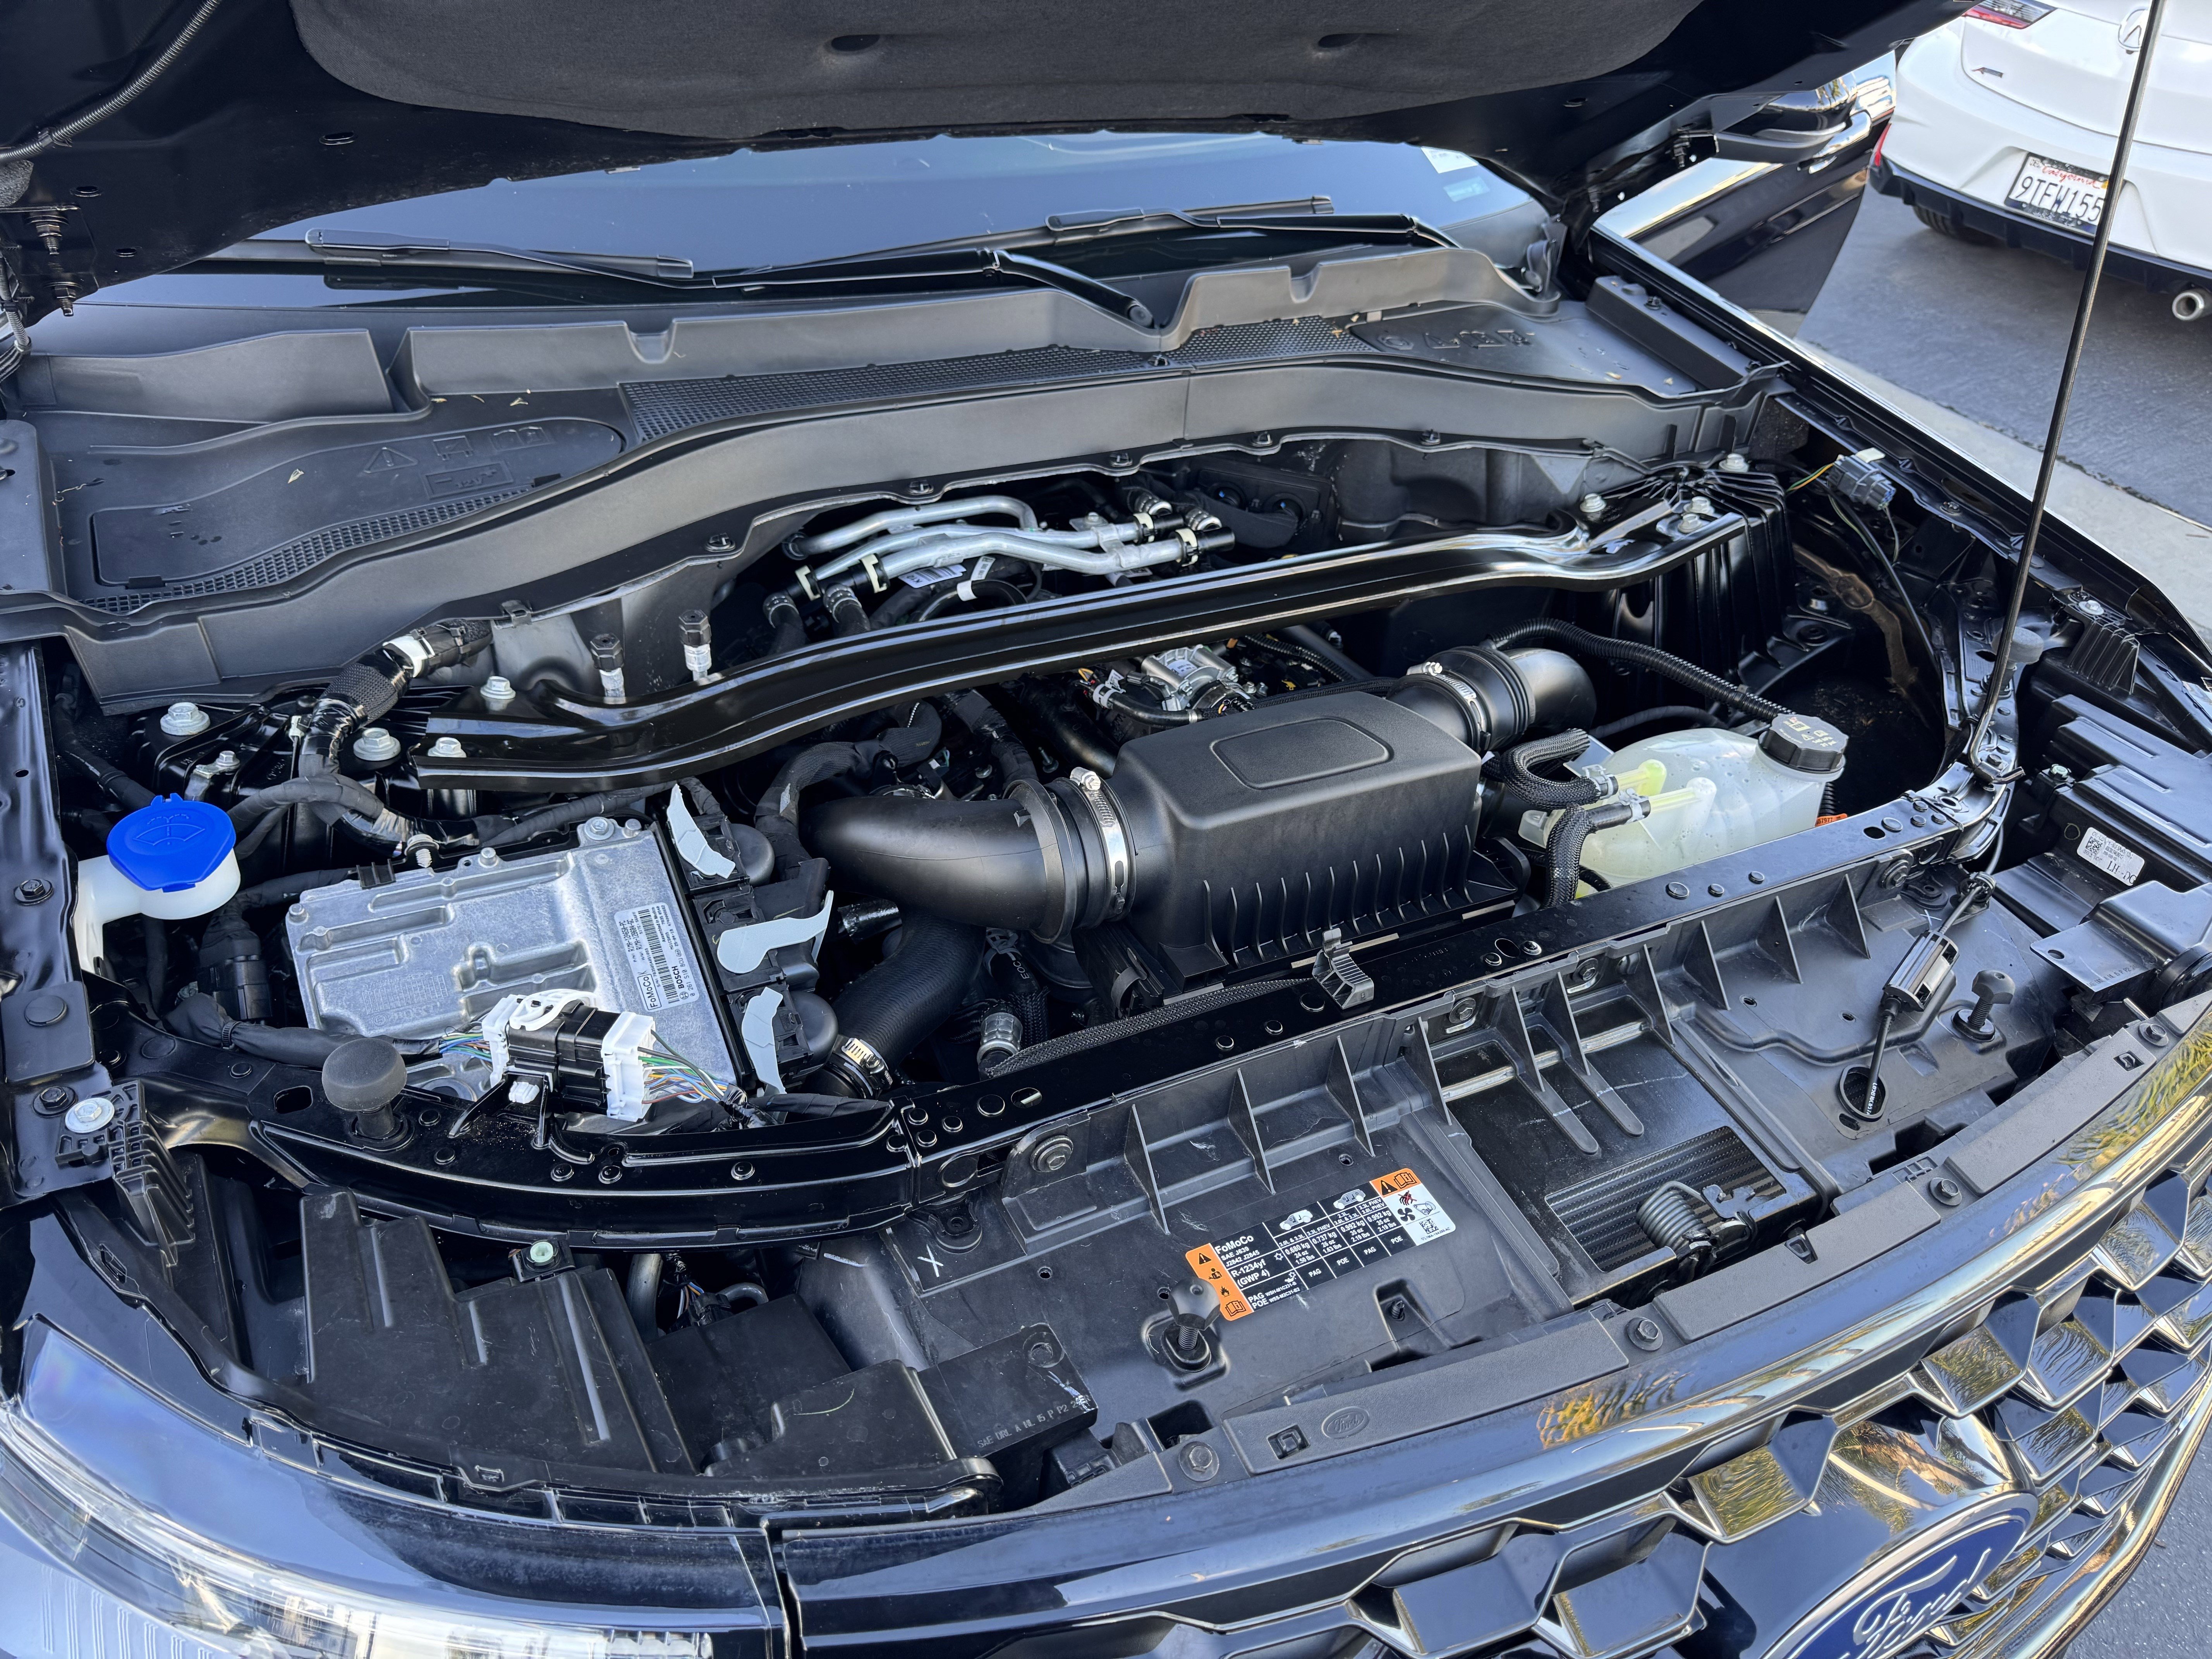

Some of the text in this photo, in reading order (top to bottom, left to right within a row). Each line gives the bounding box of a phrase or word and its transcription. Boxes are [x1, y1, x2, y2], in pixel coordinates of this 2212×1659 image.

[2016, 176, 2104, 222] 9TFW155
[656, 924, 666, 942] Assembled
[672, 965, 684, 989] BOSCH
[1013, 961, 1030, 979] EOC
[641, 976, 658, 1008] FoMoCo
[1367, 1209, 1392, 1222] 0.992 kg
[1341, 1220, 1365, 1233] 0.992 kg
[1214, 1235, 1254, 1254] FoMoCo
[1312, 1234, 1327, 1244] 0.737
[1391, 1236, 1403, 1244] POE
[1221, 1246, 1249, 1261] SAE J639
[1285, 1242, 1310, 1255] 0.680 kg
[1364, 1247, 1376, 1255] PAG
[1226, 1250, 1260, 1267] J2842 J2845
[1337, 1257, 1350, 1266] POE
[1231, 1259, 1266, 1278] R-1234yf
[1309, 1268, 1322, 1277] PAG
[1237, 1269, 1271, 1288] (GWP 4)
[1248, 1292, 1265, 1303] PAG
[1252, 1298, 1269, 1309] POE
[977, 1436, 994, 1448] SAE
[995, 1429, 1012, 1440] DRL
[1047, 1410, 1053, 1419] P
[1056, 1405, 1069, 1413] P2
[1334, 1414, 1359, 1433] Ford
[1838, 1547, 1992, 1659] Ford
